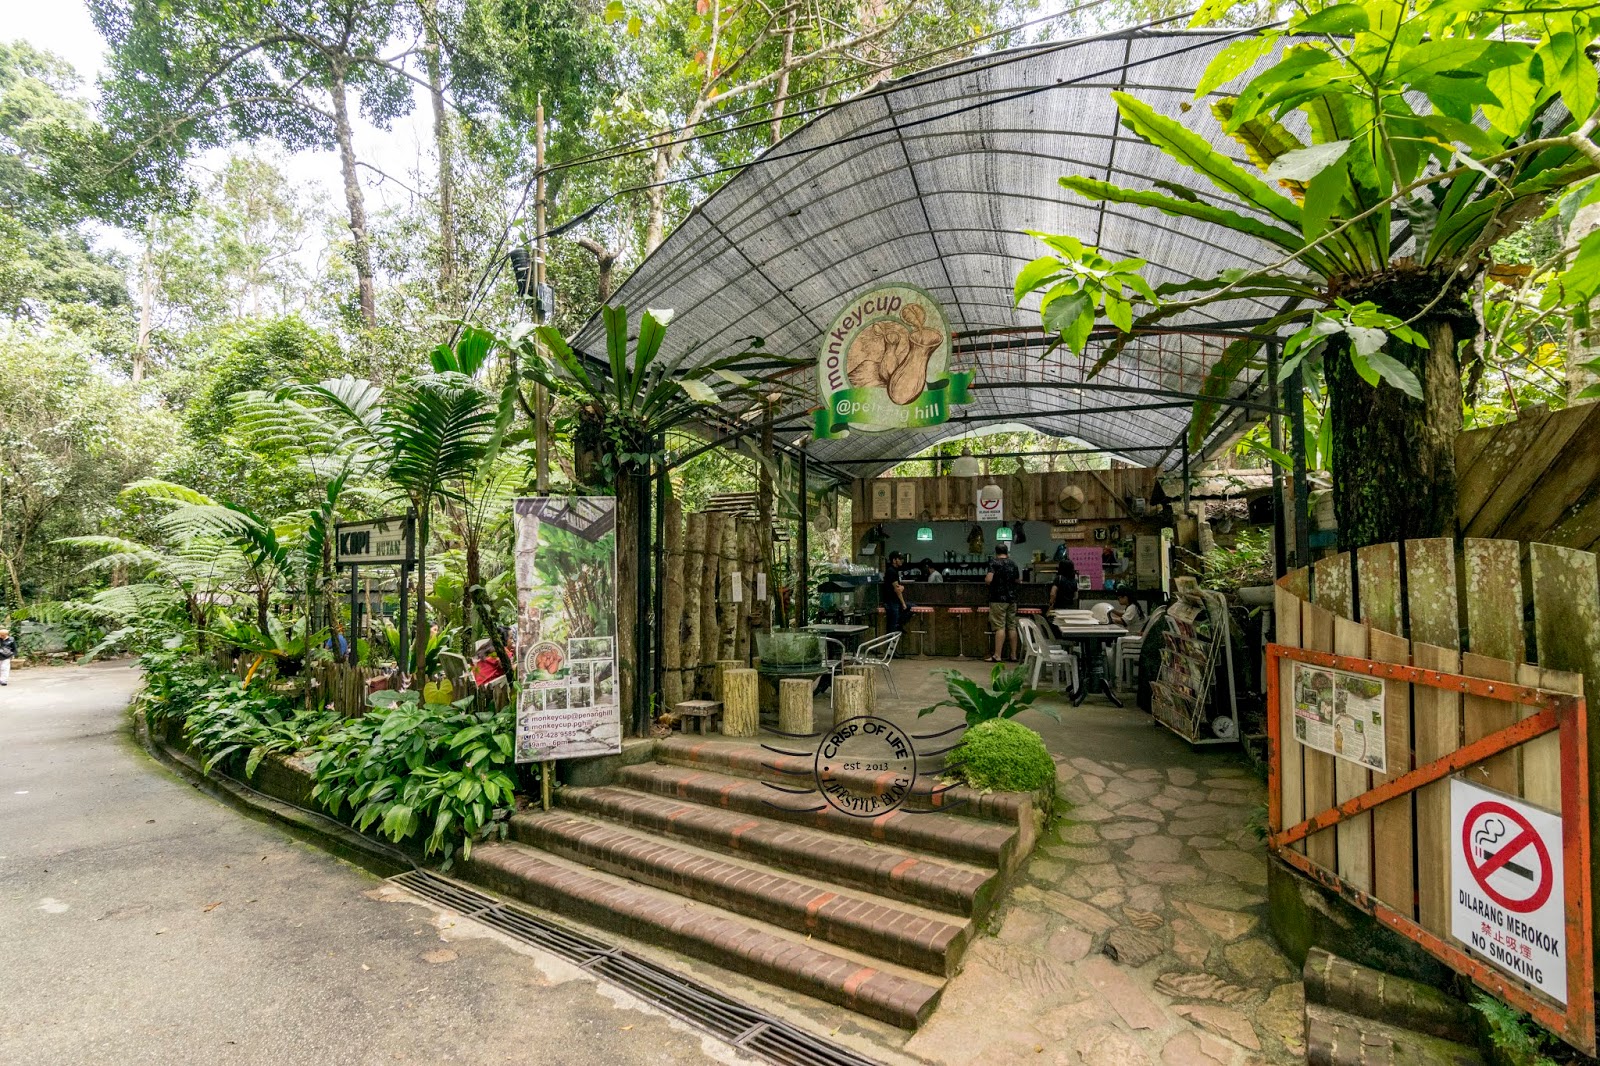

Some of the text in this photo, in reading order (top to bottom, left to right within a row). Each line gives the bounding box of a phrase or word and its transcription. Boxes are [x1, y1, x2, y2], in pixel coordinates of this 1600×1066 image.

[826, 295, 902, 391] monkeycup
[836, 399, 940, 422] @penng hill
[340, 530, 370, 556] KOPI
[531, 710, 613, 721] monkeycup@penanghill
[531, 720, 592, 730] monkeycup.pgh
[1459, 888, 1559, 957] DILARANG MEROKOK
[1471, 931, 1543, 984] NO SMOKING
[1481, 921, 1533, 961] 禁止吸煙
